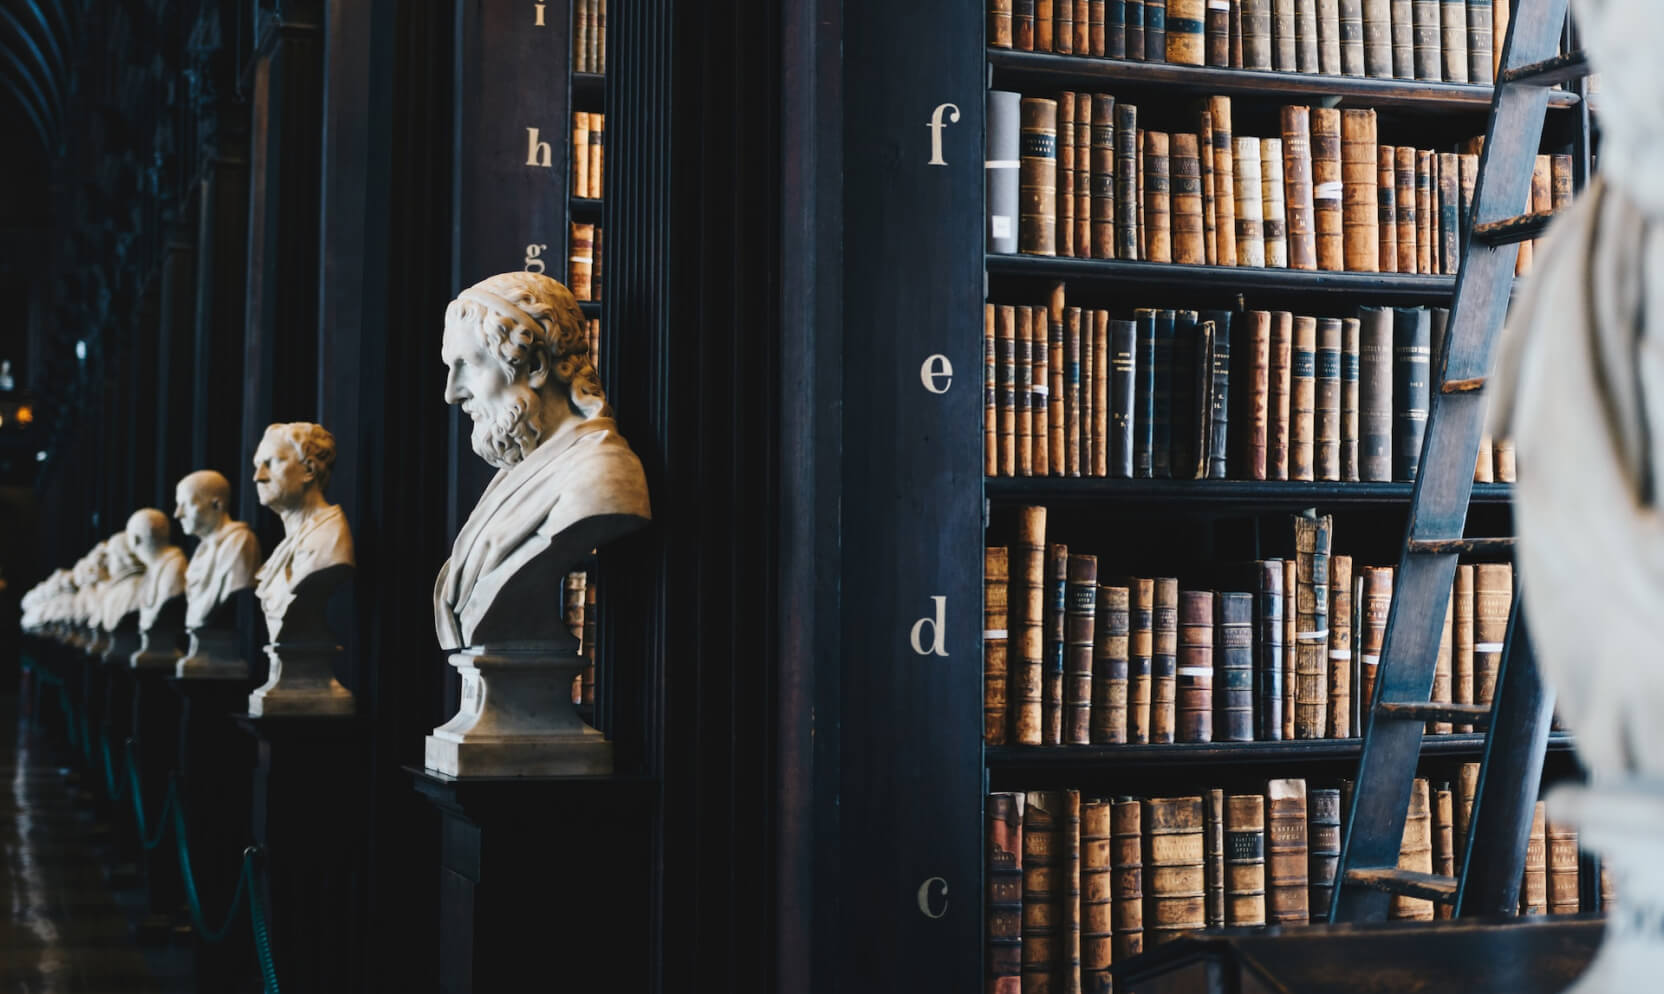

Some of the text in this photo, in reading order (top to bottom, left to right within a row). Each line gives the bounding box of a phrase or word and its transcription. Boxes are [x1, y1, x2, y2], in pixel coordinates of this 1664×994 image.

[525, 127, 552, 167] h
[926, 103, 960, 166] f
[524, 243, 547, 274] g
[921, 354, 953, 394] e
[910, 596, 950, 657] d
[918, 877, 949, 919] c
